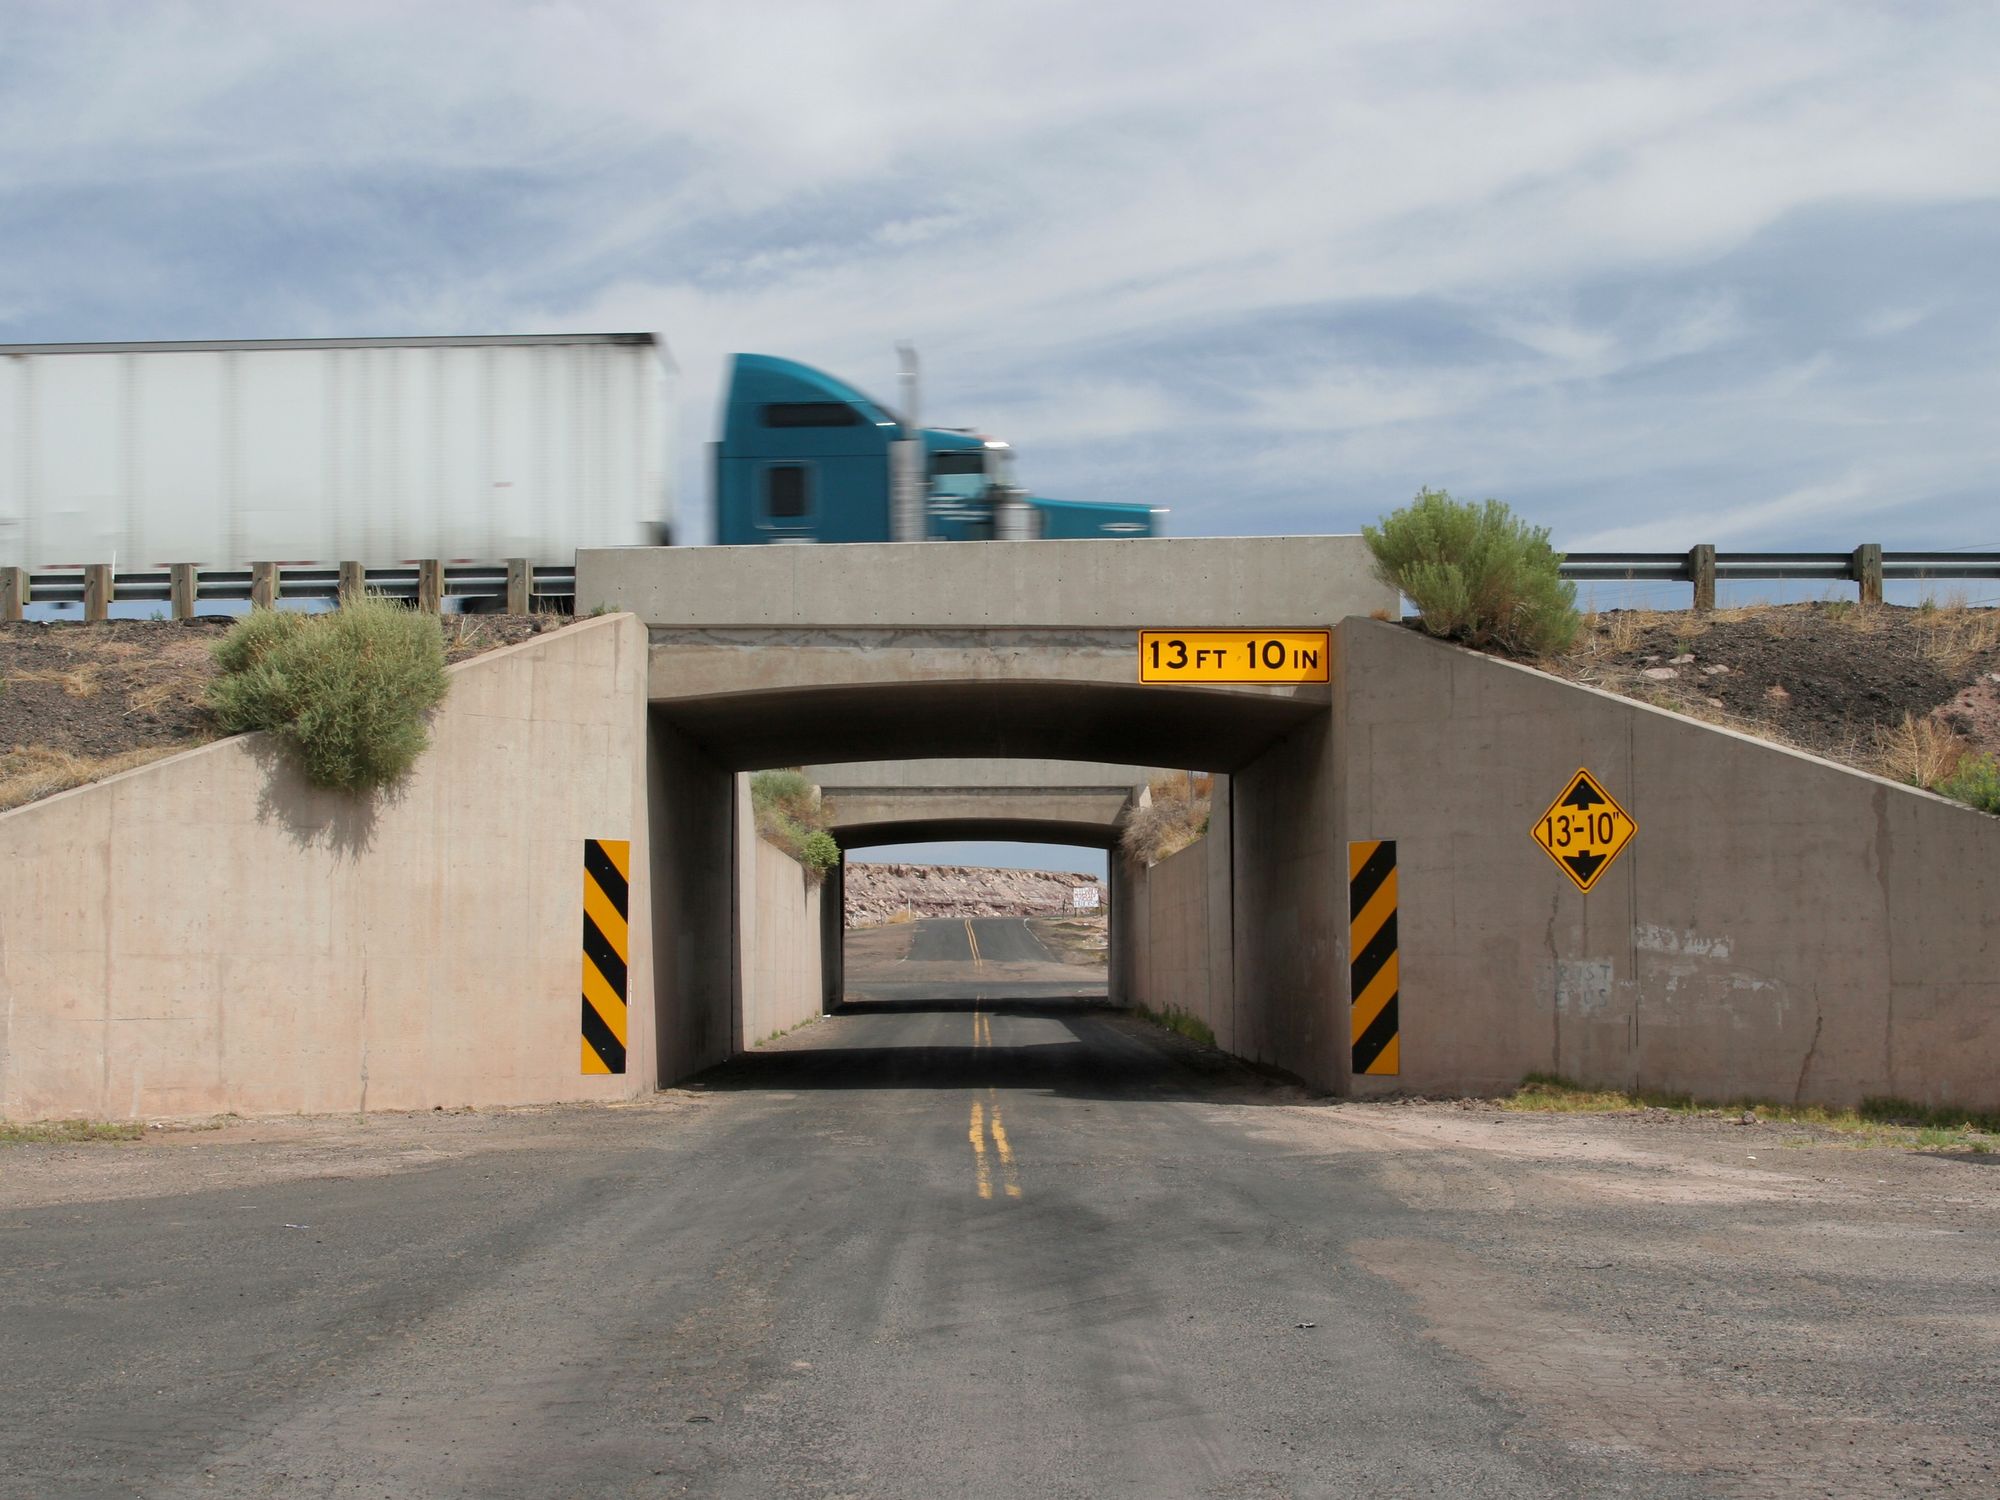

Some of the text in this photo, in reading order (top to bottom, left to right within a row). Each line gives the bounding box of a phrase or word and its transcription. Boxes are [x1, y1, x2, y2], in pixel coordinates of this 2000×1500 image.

[1150, 640, 1318, 669] 13 FT 10 IN
